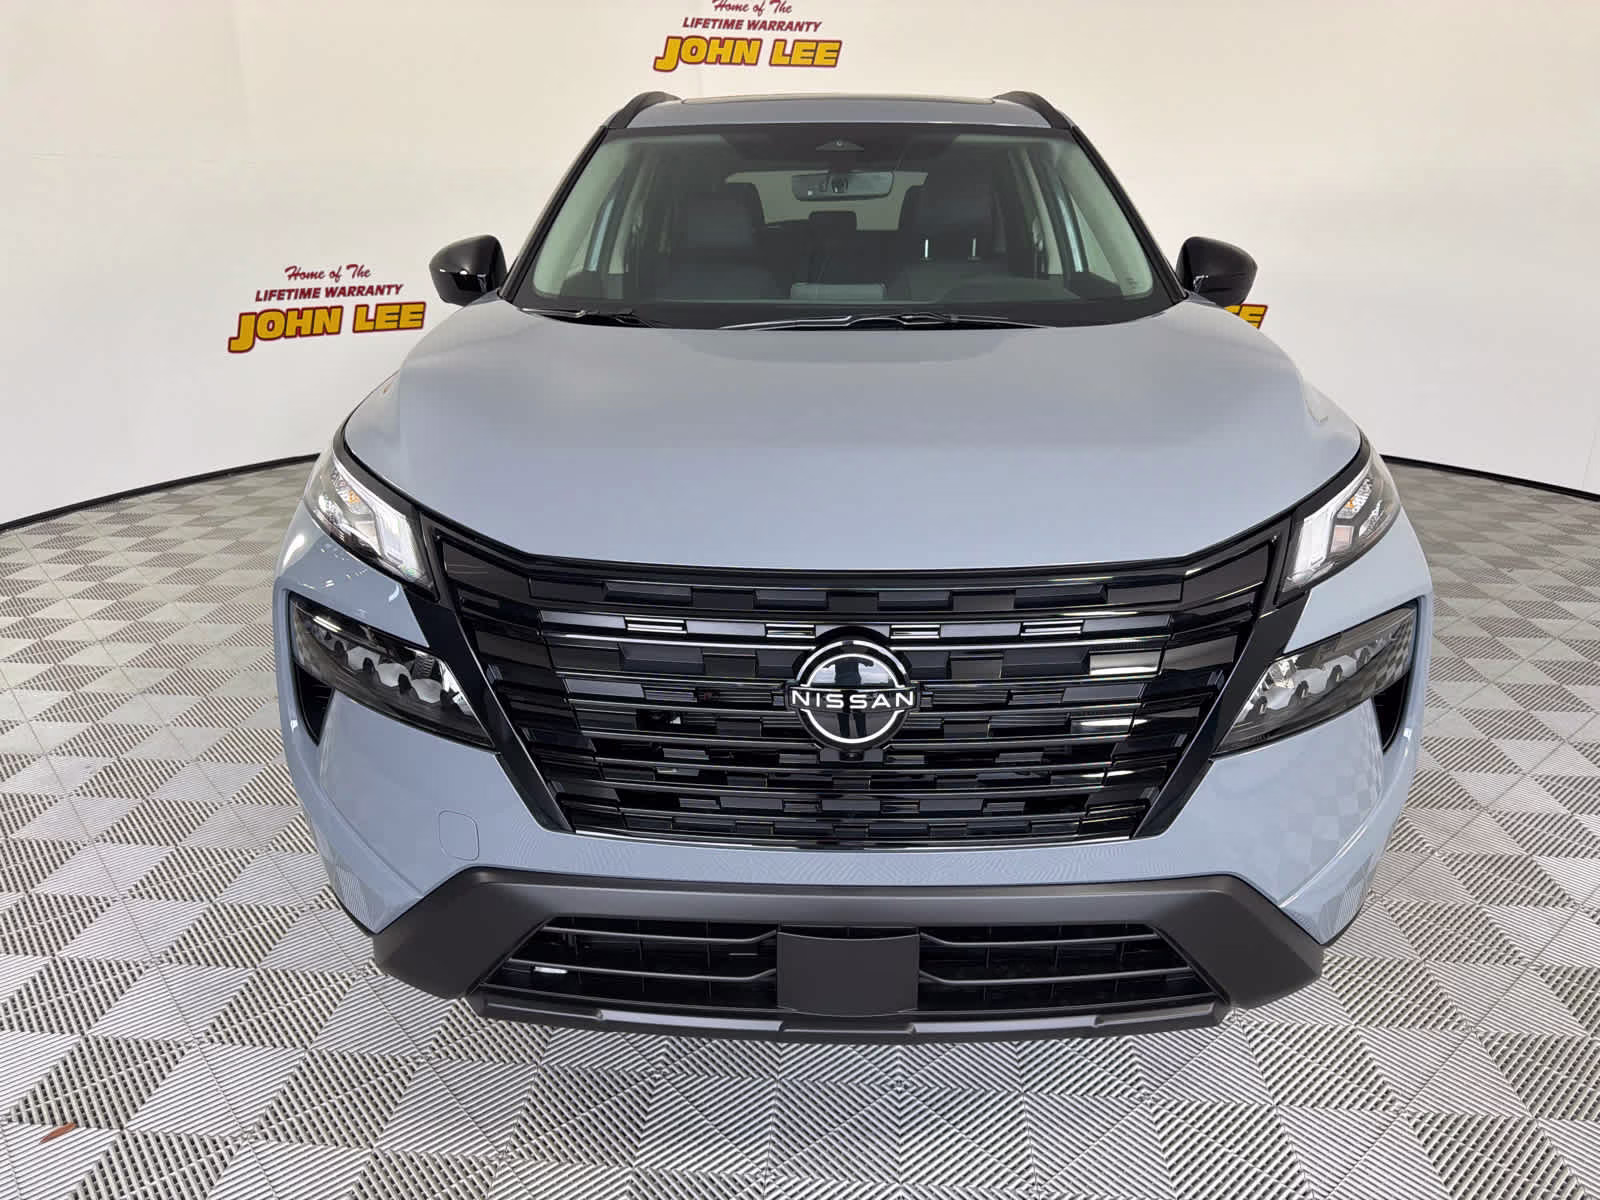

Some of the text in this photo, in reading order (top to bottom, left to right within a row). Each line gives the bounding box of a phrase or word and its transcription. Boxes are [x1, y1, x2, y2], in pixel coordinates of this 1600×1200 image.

[711, 0, 793, 16] Home of The
[682, 17, 822, 33] LIFETIME WARRANTY
[653, 35, 842, 72] JOHN LEE
[284, 264, 371, 283] Home of The
[255, 284, 403, 302] LIFETIME WARRANTY
[228, 301, 426, 353] JOHN LEE
[791, 690, 914, 709] NISSAN
